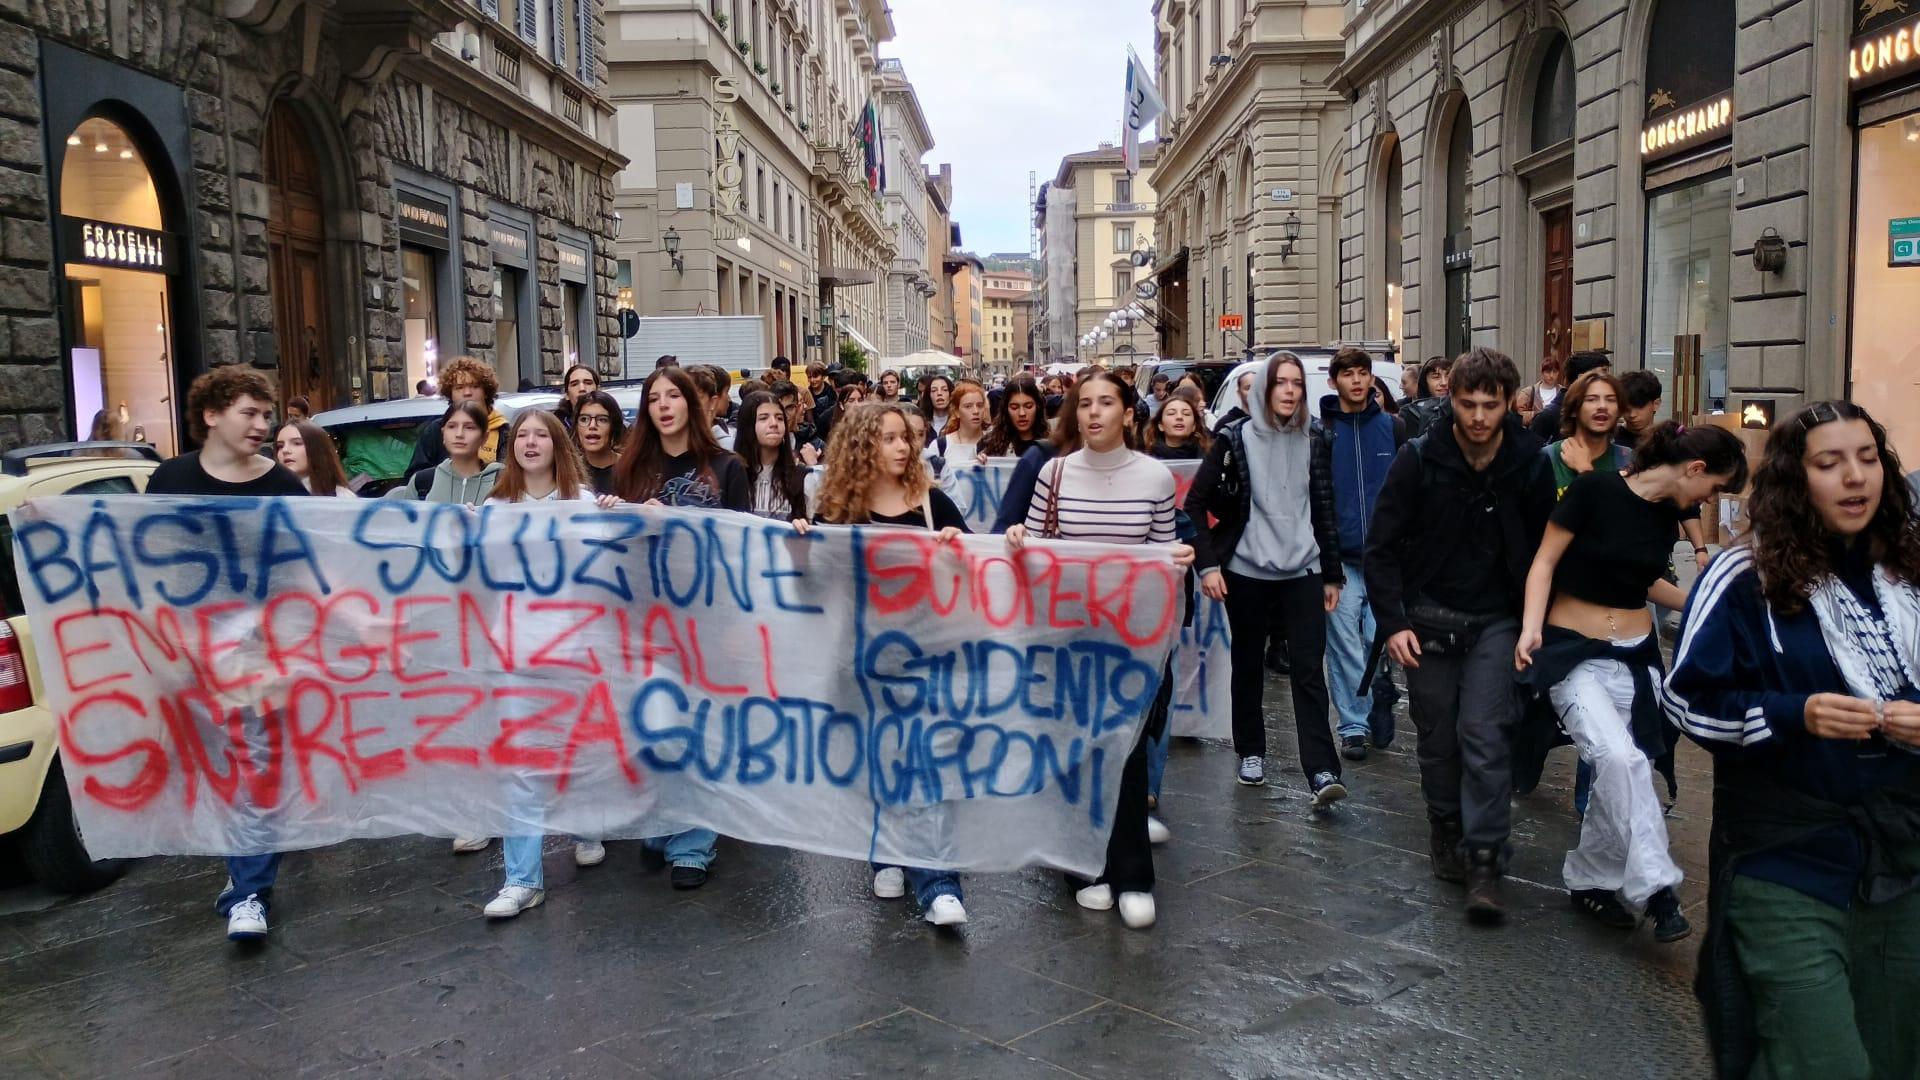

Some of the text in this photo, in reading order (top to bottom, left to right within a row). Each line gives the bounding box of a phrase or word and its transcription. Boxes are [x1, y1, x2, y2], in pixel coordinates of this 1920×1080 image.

[714, 77, 743, 216] SAVOY
[1641, 98, 1730, 154] LONGCHAMP
[83, 224, 162, 252] FRATELLI
[84, 240, 163, 266] ROSSETTI
[1897, 245, 1909, 253] C1
[1221, 319, 1239, 328] TAXI
[14, 500, 825, 616] BASTA SOLUZIONE
[866, 531, 1177, 647] SCIOPERO
[53, 590, 780, 700] EMERGENZIALI
[59, 677, 866, 813] SICUREZZA SUBITO
